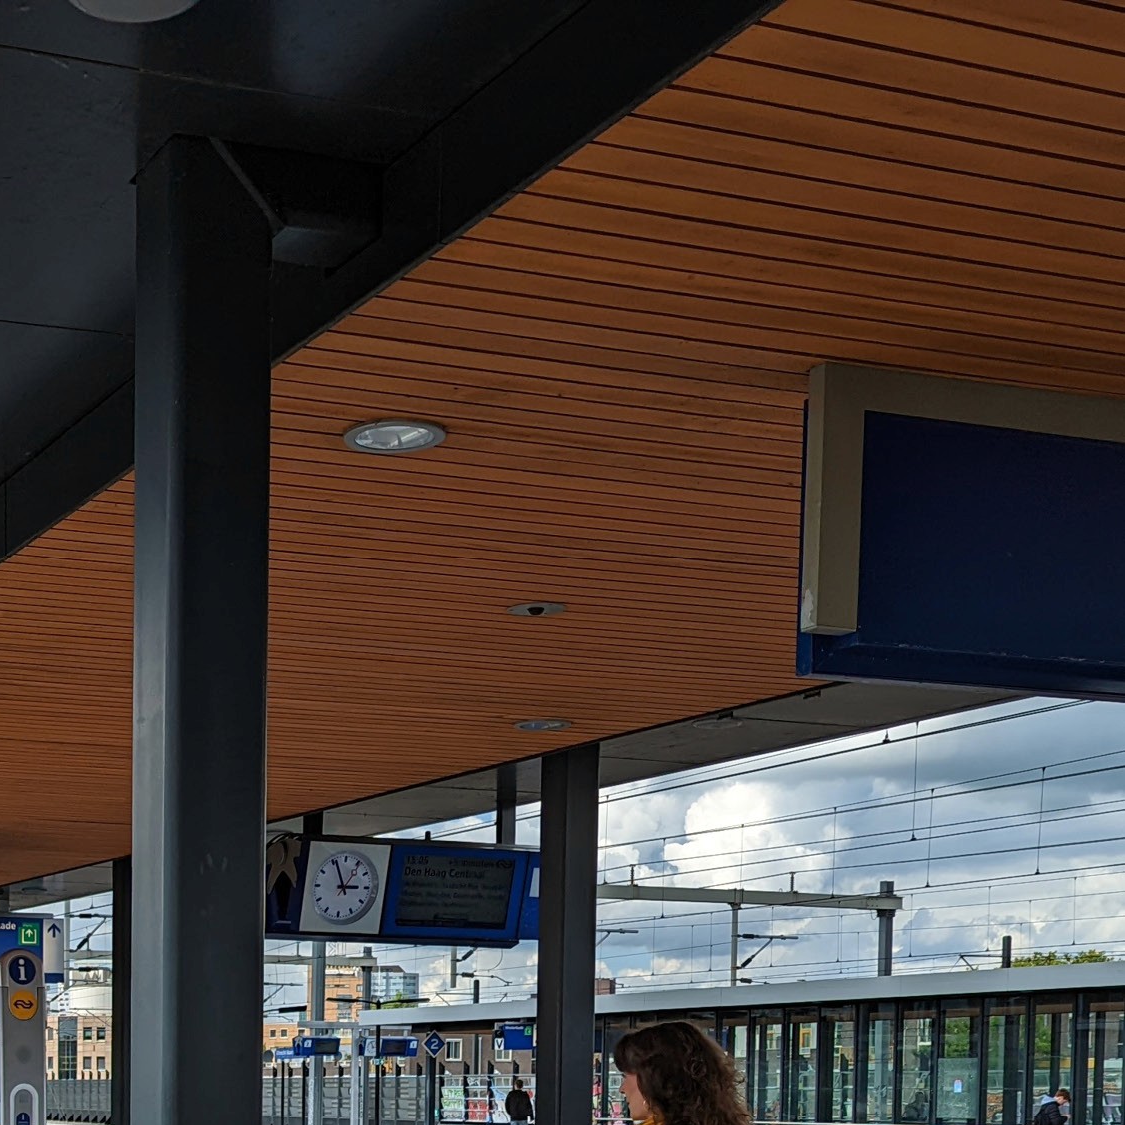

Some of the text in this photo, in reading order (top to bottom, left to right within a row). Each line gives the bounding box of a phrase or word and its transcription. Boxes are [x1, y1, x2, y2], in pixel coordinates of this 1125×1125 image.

[404, 866, 422, 876] Den
[424, 868, 447, 879] Haag
[430, 1038, 439, 1050] 2
[495, 1039, 504, 1050] V
